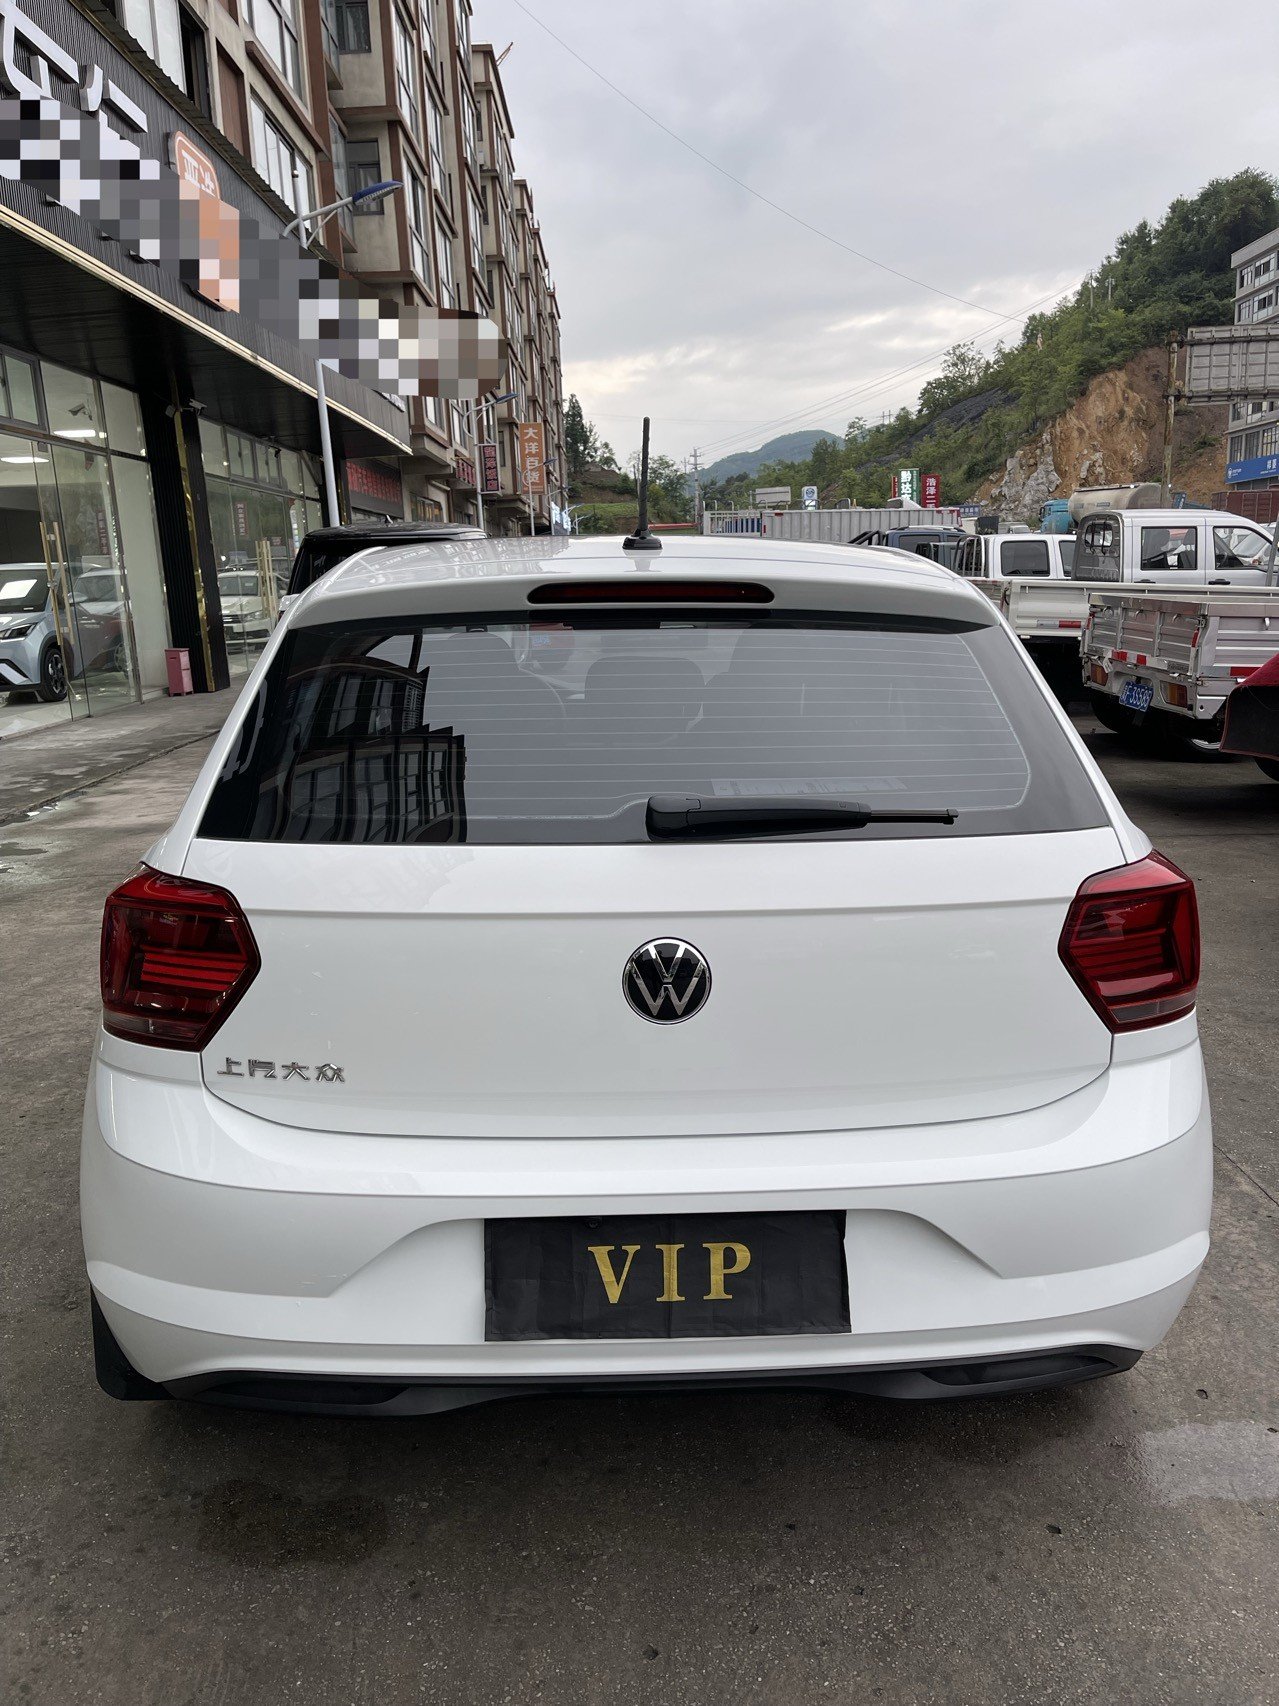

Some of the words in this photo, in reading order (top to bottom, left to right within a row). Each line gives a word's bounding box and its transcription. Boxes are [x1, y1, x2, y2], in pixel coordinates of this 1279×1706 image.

[523, 427, 541, 483] 大洋百货
[217, 1057, 345, 1082] 上汽大众
[588, 1242, 751, 1304] VIP
